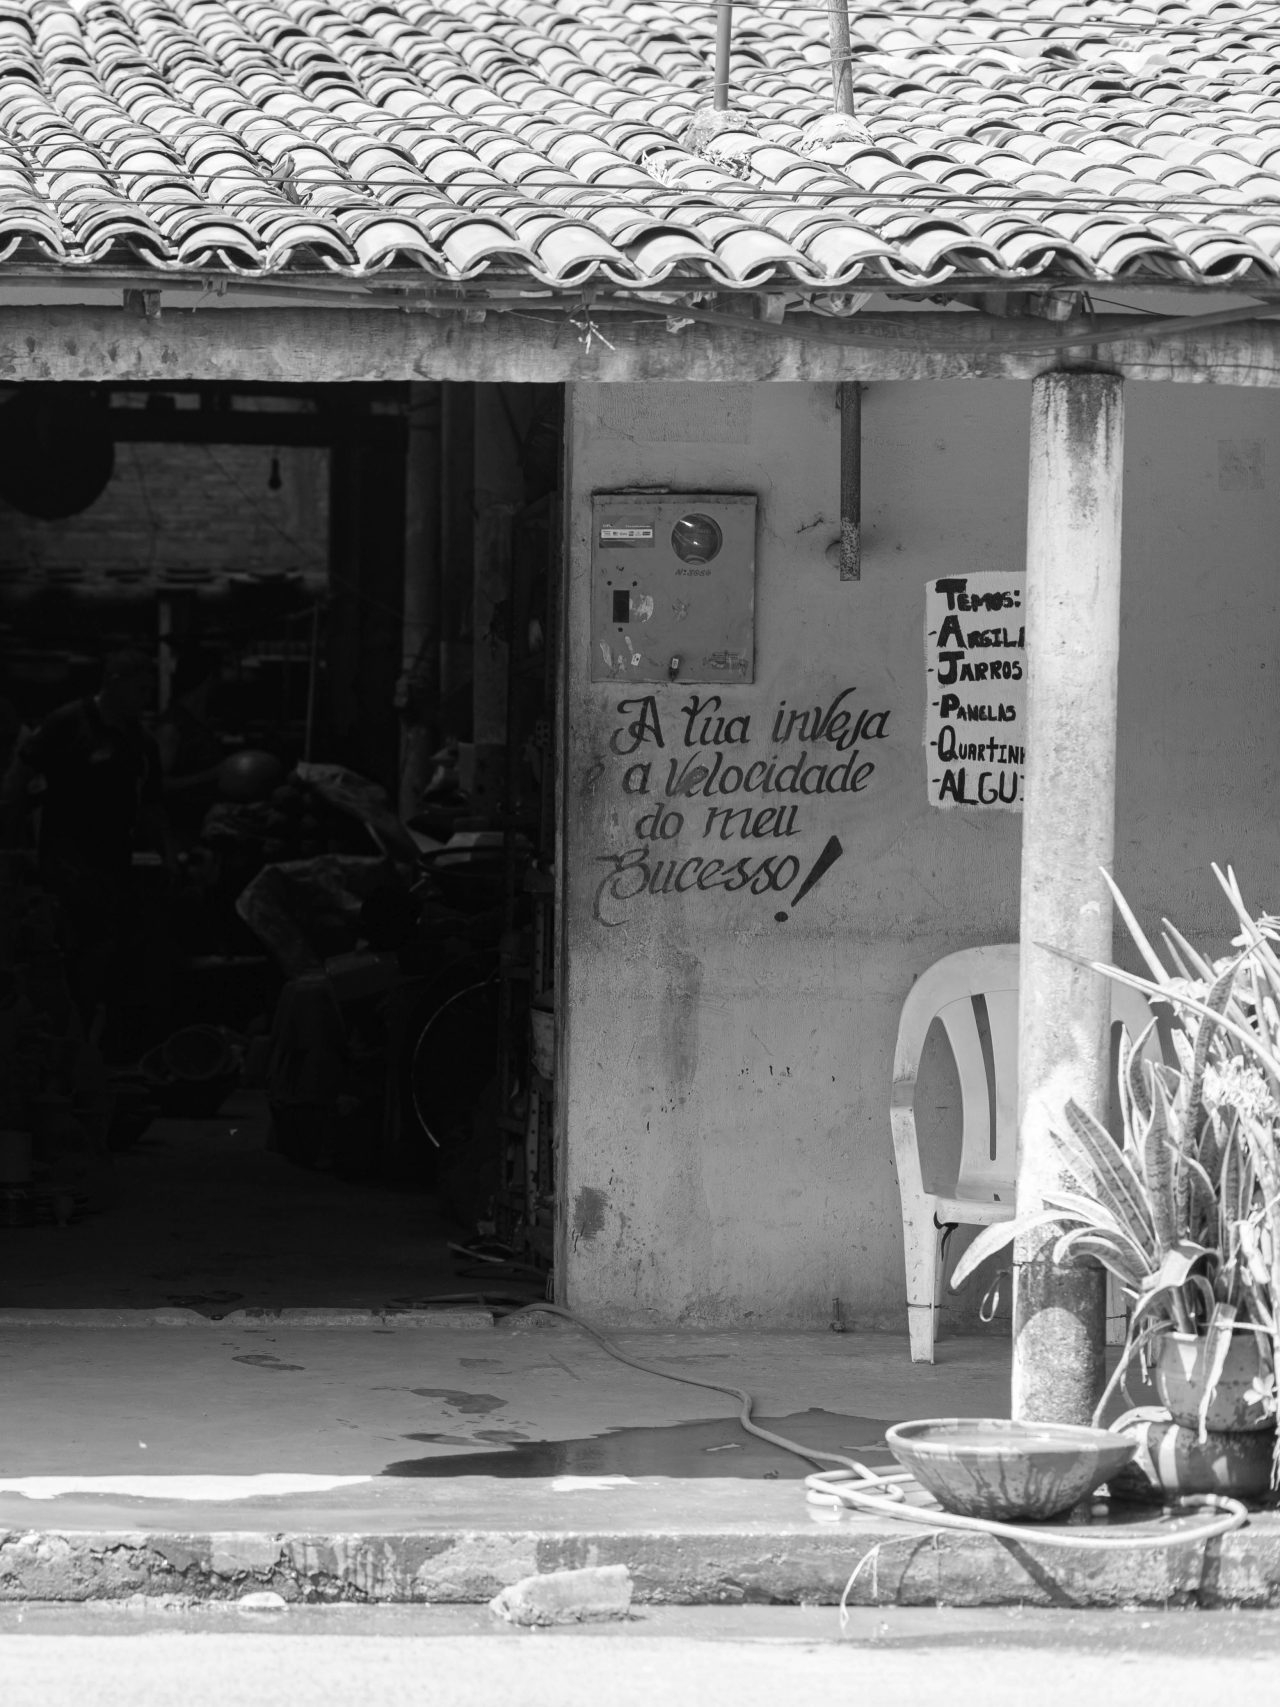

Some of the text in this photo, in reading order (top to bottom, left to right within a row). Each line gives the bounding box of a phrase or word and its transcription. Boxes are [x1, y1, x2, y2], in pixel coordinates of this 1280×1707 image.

[609, 694, 665, 756] A
[621, 761, 653, 796] a
[634, 803, 802, 841] do meu
